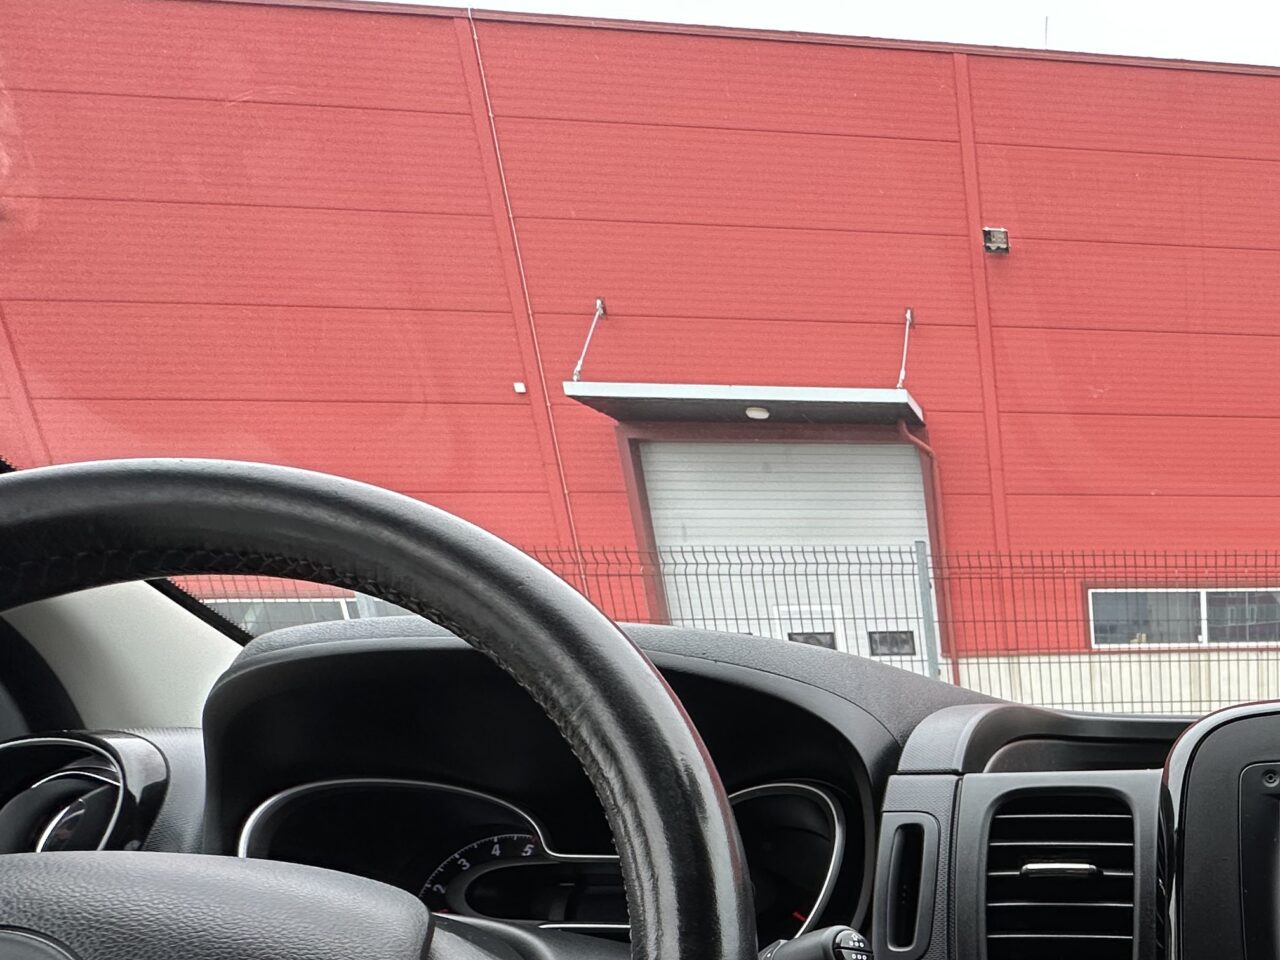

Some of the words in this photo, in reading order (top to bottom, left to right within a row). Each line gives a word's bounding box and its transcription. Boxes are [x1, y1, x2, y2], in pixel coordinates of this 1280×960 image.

[490, 844, 500, 857] 4
[521, 844, 534, 857] 5
[457, 858, 471, 871] 3
[432, 883, 446, 895] 2
